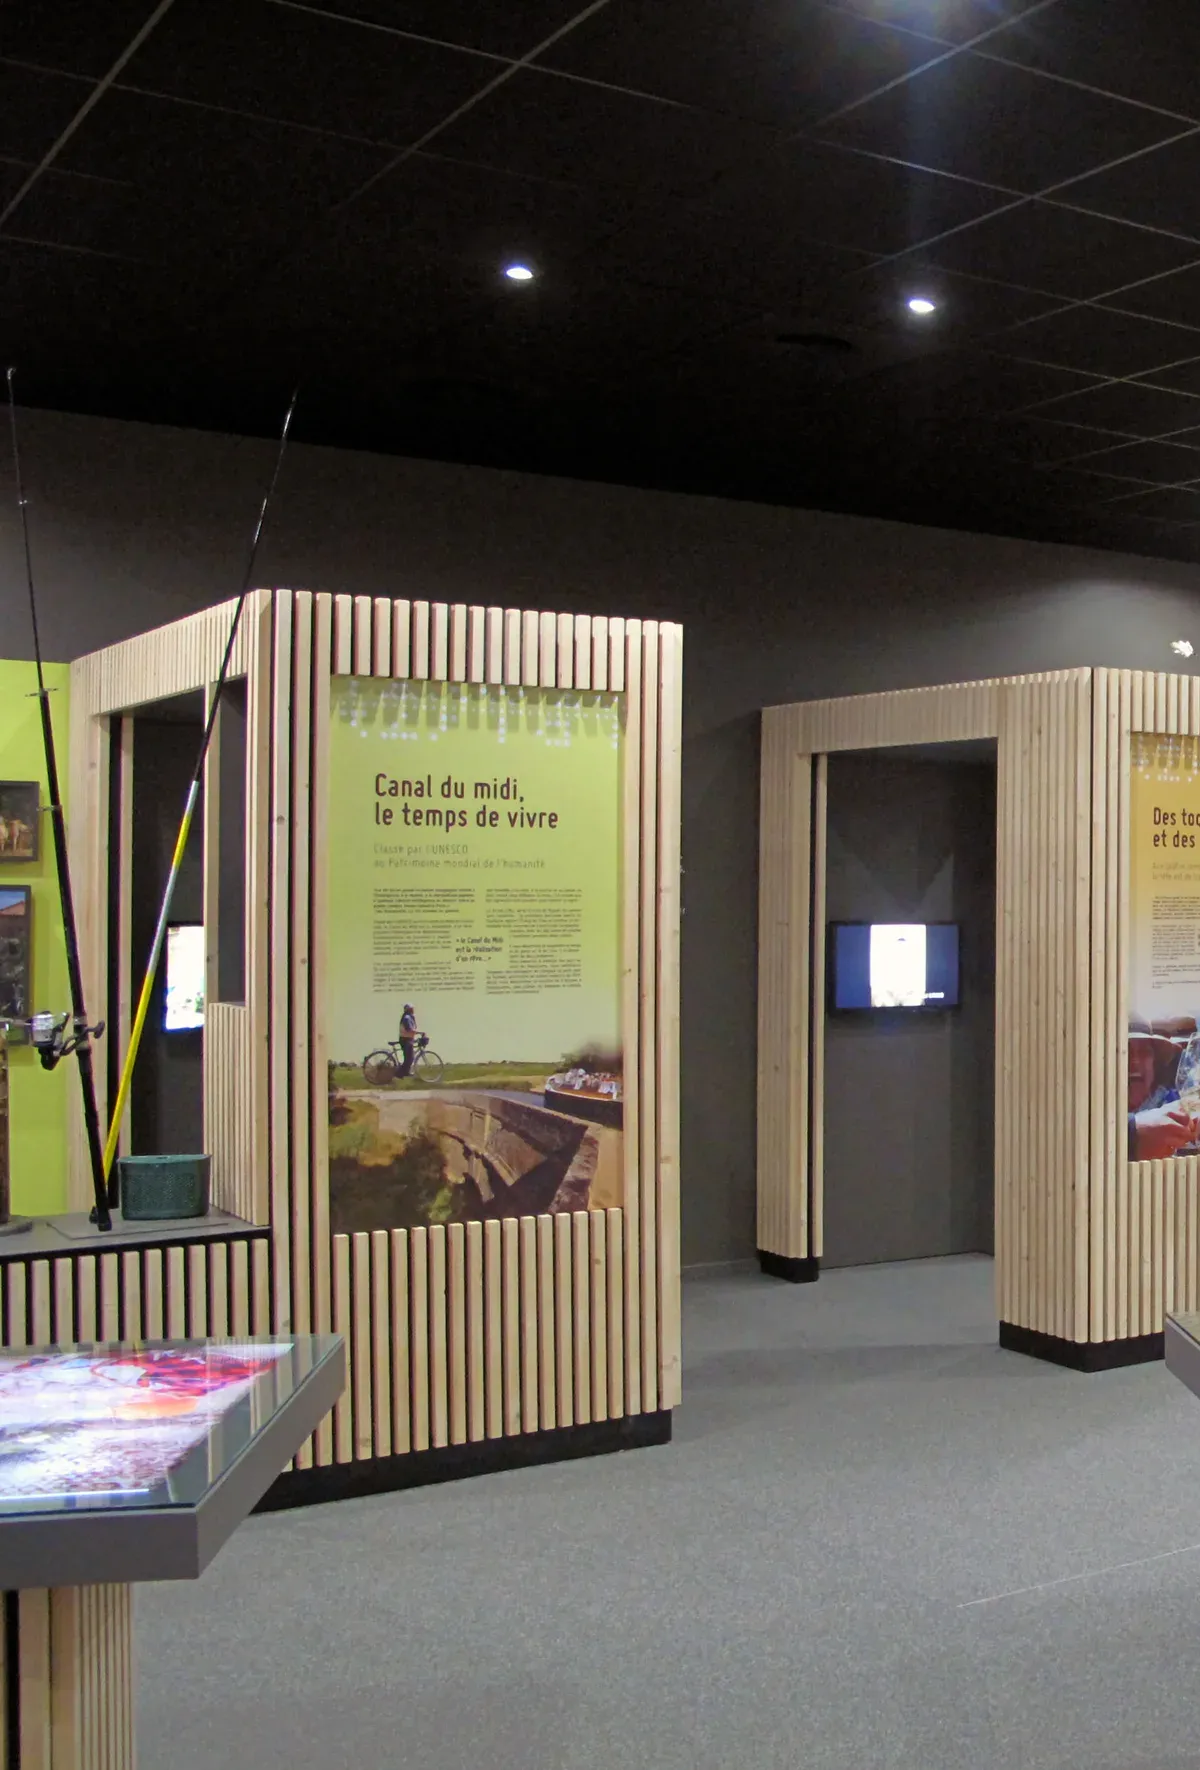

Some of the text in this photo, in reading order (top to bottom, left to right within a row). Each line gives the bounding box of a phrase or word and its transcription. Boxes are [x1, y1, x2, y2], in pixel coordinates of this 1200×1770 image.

[375, 772, 524, 803] Canal du midi,
[375, 802, 559, 833] le temps de vivre
[1153, 806, 1176, 826] Des
[1153, 829, 1167, 848] et
[1173, 830, 1196, 848] des
